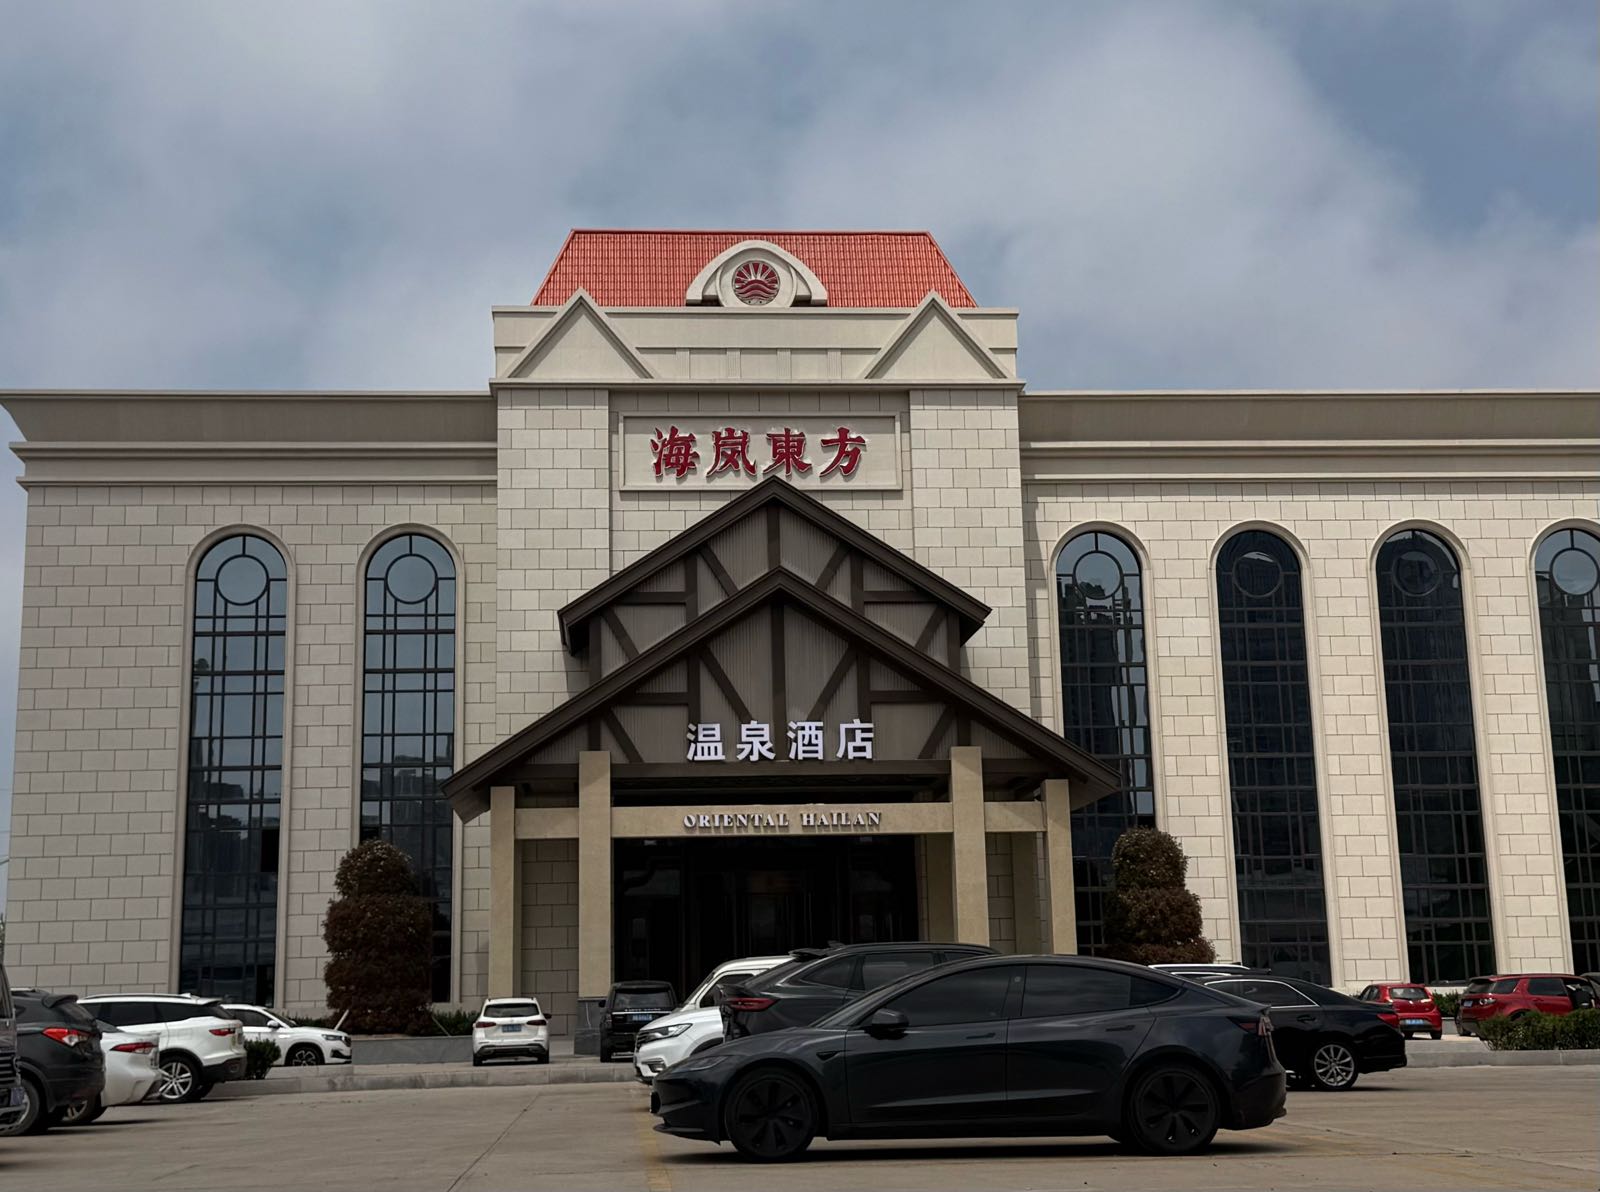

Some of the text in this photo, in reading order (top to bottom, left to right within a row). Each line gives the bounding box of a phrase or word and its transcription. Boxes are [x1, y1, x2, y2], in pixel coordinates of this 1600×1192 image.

[686, 718, 874, 761] 温泉酒店
[683, 811, 882, 828] ORIENTAL HAILAN
